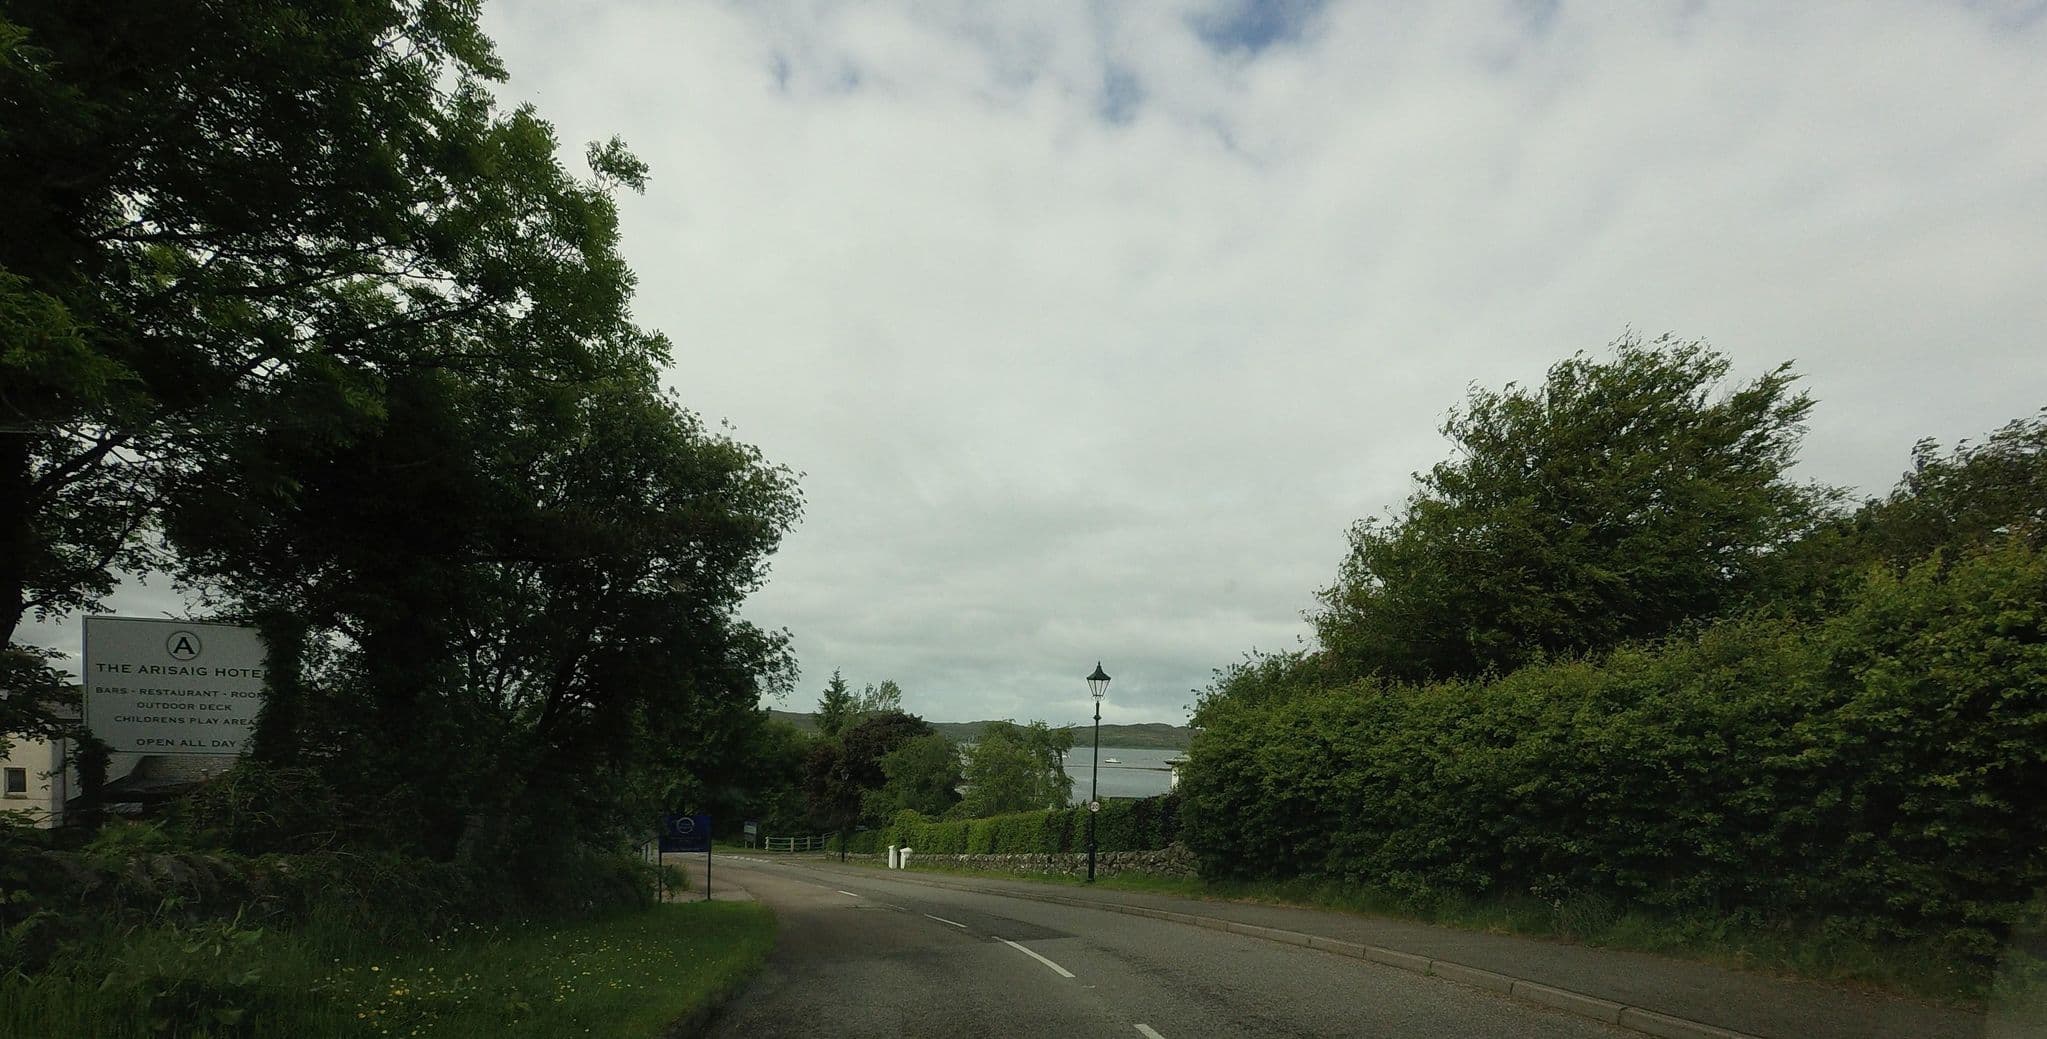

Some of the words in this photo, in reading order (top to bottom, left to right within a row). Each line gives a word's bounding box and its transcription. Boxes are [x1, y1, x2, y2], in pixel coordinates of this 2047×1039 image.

[172, 636, 195, 655] A
[96, 663, 132, 674] THE
[138, 664, 208, 677] ARISAIG
[95, 686, 128, 695] BARS
[139, 688, 221, 698] RESTAURANT
[136, 701, 195, 710] OUTDOOR
[200, 703, 233, 711] DECK
[114, 715, 186, 724] CHILDRENS
[189, 717, 220, 725] PLAY
[222, 718, 257, 726] AREA
[136, 738, 175, 747] OPEN
[179, 739, 207, 748] ALL
[211, 739, 237, 748] DAY
